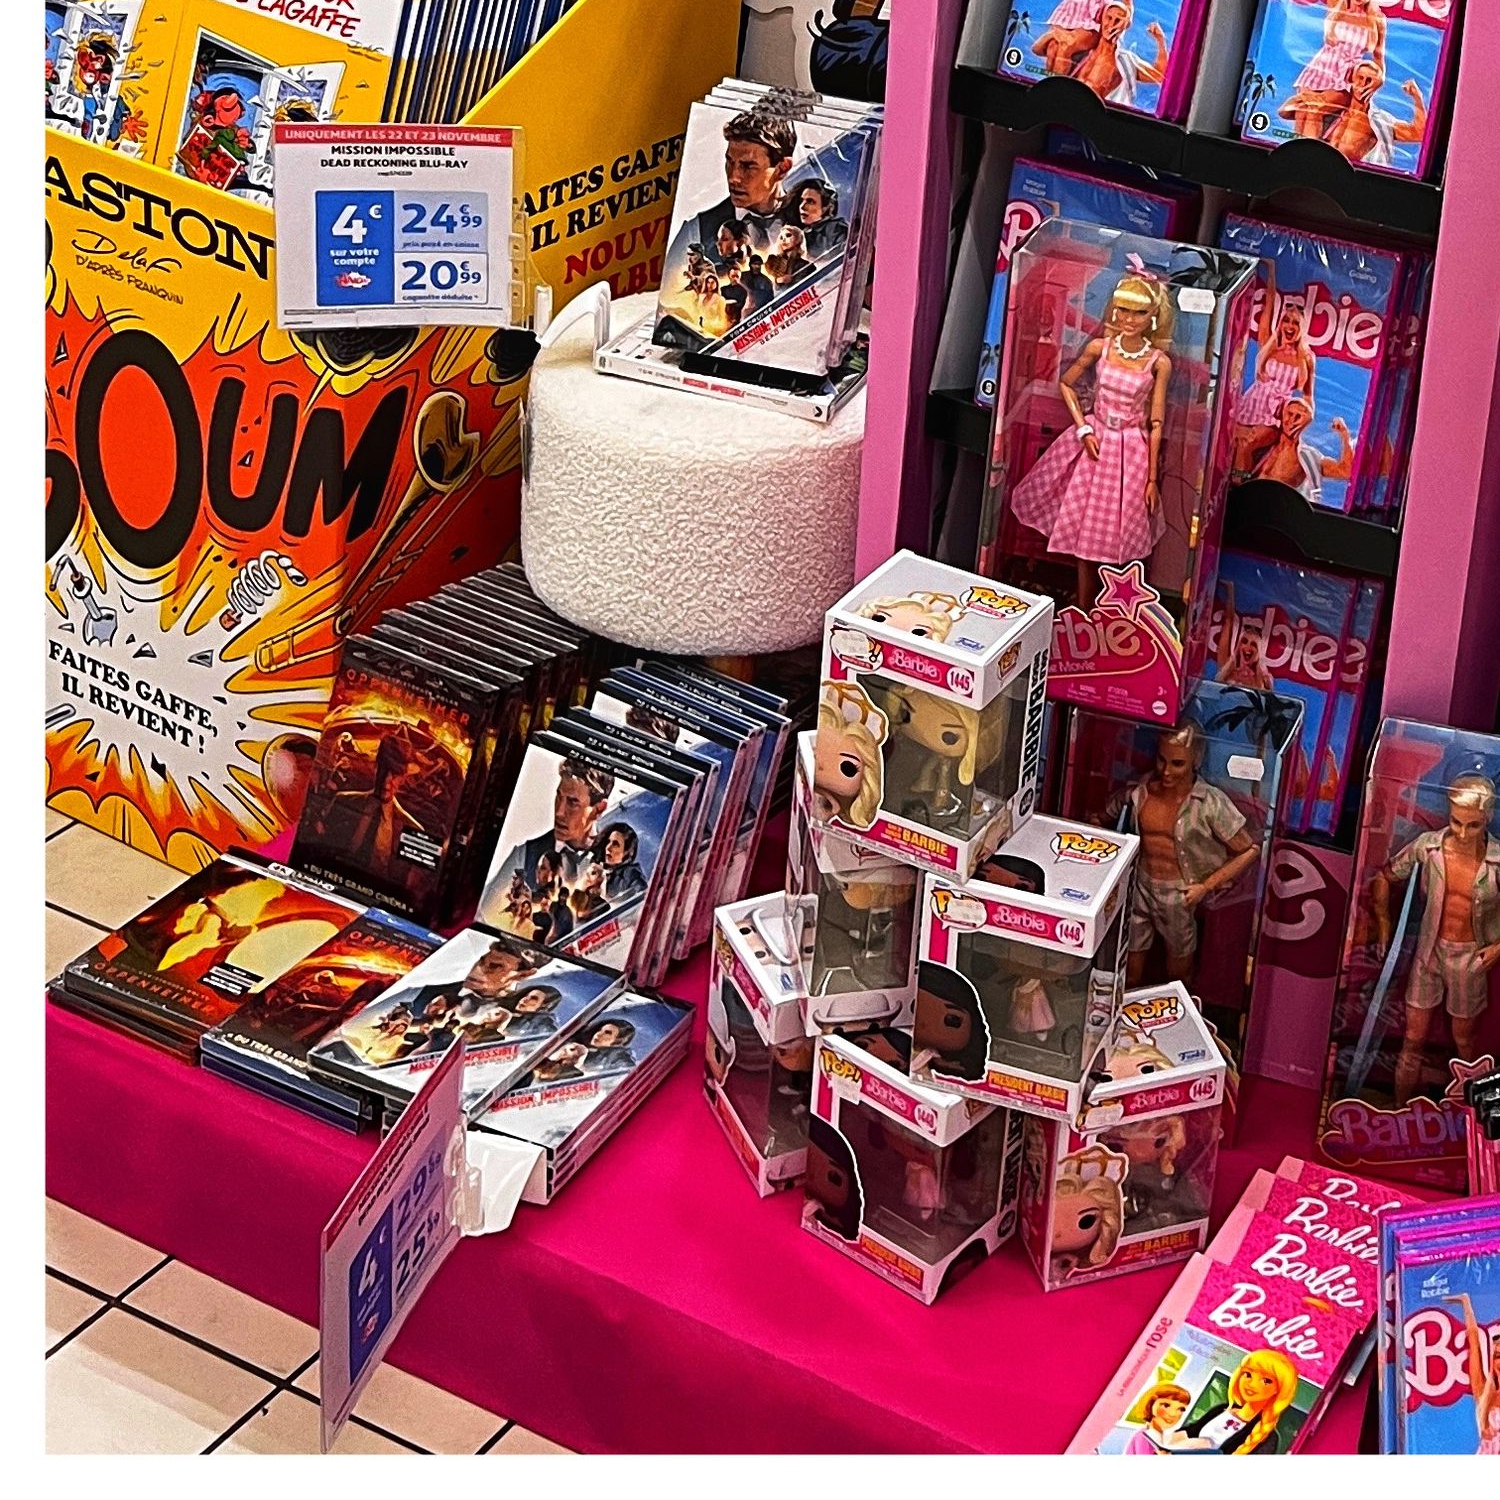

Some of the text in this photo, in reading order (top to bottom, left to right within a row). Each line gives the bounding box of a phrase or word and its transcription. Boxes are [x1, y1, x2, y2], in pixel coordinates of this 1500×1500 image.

[285, 129, 501, 143] UNIQUEMENT LES 22 ET 23 NOVEMBRE
[331, 145, 456, 156] MISSION IMPOSSIBLE
[320, 159, 468, 169] DEAD RECKONING BLU-RAY
[525, 165, 604, 217] AITES
[531, 219, 560, 252] IL
[330, 248, 379, 257] sur votre
[334, 257, 376, 267] compte
[127, 274, 184, 305] FRANQUIN
[769, 286, 818, 326] IMPOSSIBLE
[970, 586, 1031, 615] POP!
[888, 649, 971, 693] Barbie 1445
[48, 641, 219, 737] FAITES GAFFE,
[346, 669, 471, 726] OPPENHEIMER
[61, 672, 194, 744] IL REVIENT
[1020, 681, 1046, 789] BARBIE
[901, 831, 950, 855] BARBIE
[1058, 831, 1121, 858] POP!
[992, 905, 1048, 932] Barbie
[1122, 996, 1178, 1025] POP!
[867, 1076, 908, 1114] Barbie
[1130, 1087, 1179, 1111] Barbie
[1252, 1233, 1363, 1315] Barbie
[1145, 1316, 1173, 1349] rose
[1209, 1282, 1324, 1365] Barbie
